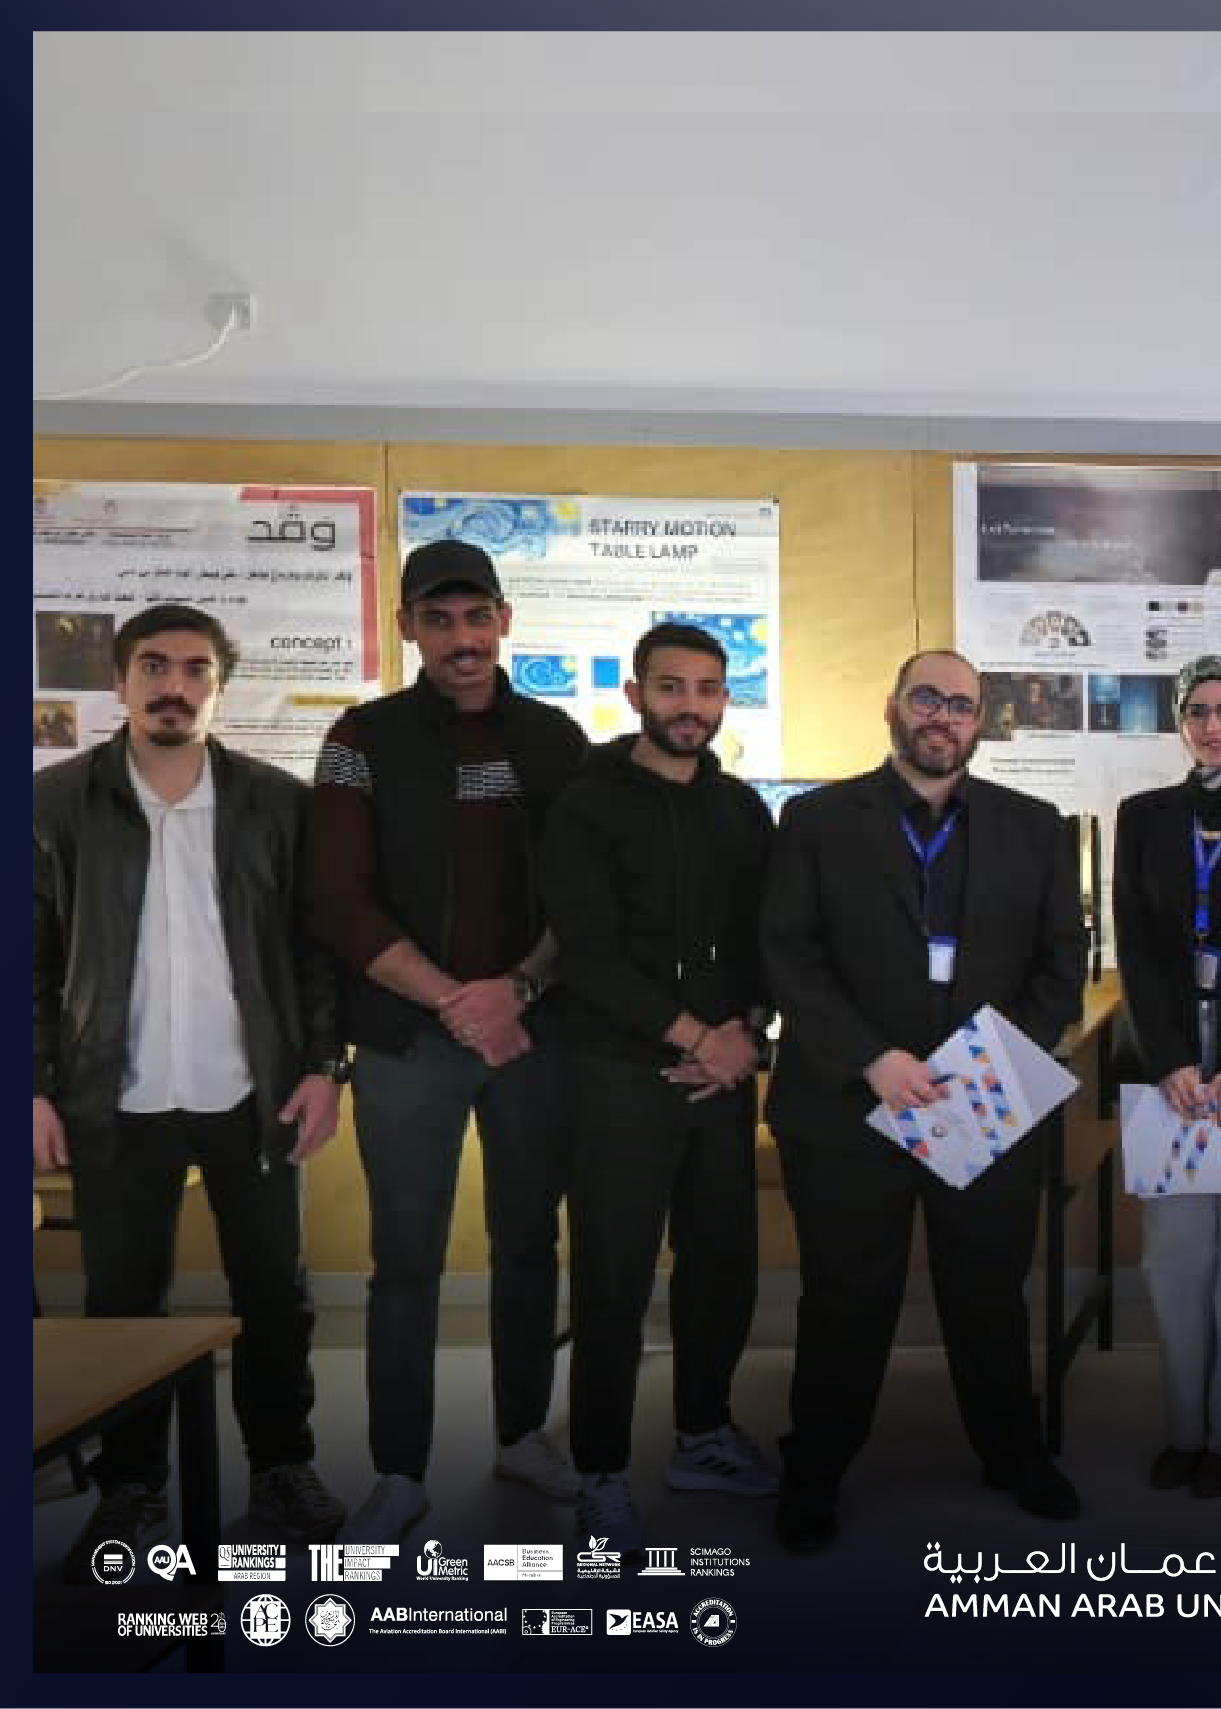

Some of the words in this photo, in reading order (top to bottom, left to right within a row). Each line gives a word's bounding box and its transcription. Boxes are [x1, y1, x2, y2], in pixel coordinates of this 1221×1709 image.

[588, 518, 657, 536] STARRY
[664, 519, 737, 537] MOTION
[588, 542, 648, 559] TABLE
[651, 544, 699, 560] LAMP
[270, 637, 341, 654] concept
